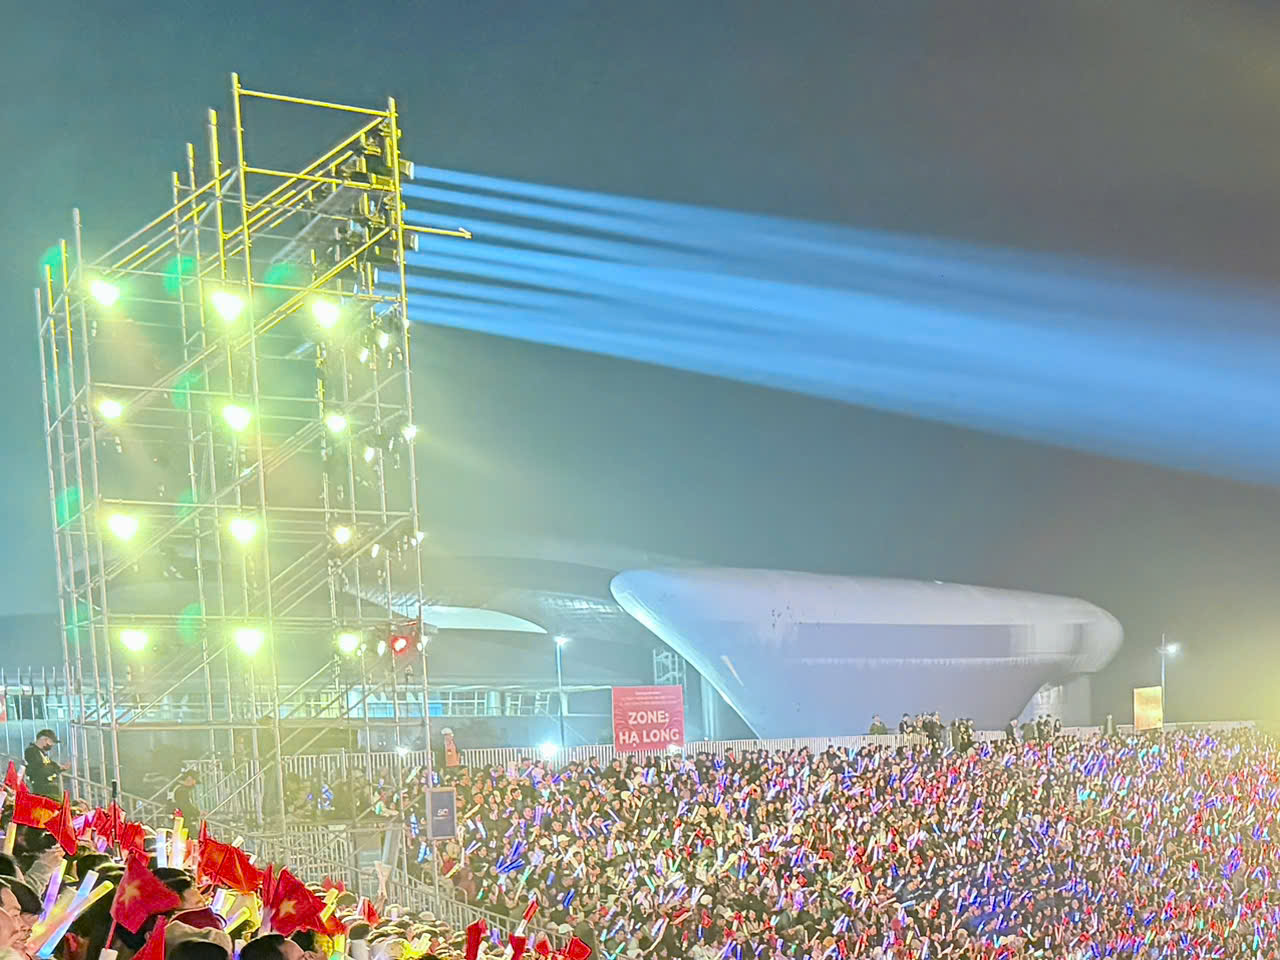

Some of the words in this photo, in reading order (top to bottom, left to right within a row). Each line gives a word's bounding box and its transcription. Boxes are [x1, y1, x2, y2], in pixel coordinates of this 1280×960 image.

[628, 710, 669, 725] ZONE:
[619, 730, 640, 747] HẠ
[643, 728, 680, 743] LONG
